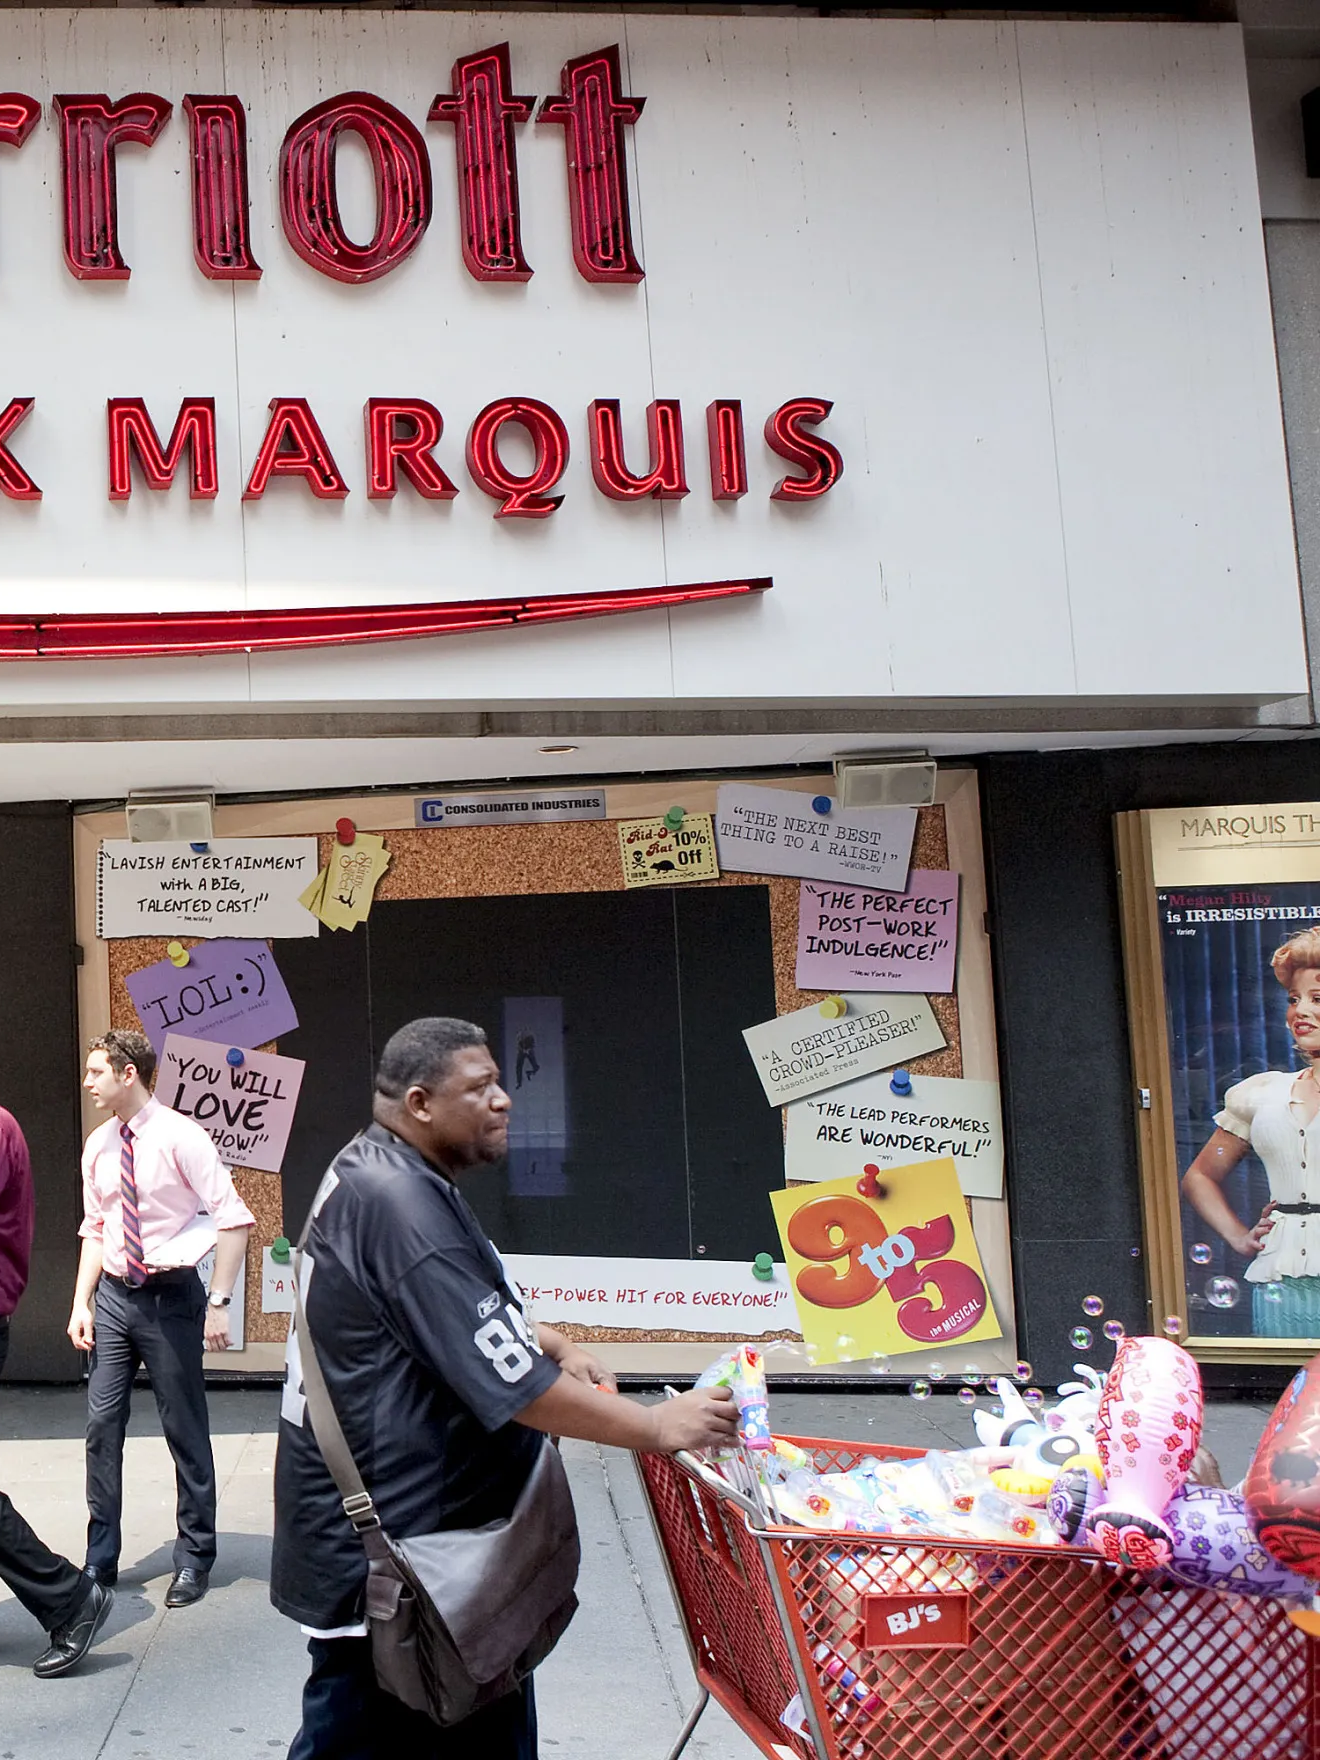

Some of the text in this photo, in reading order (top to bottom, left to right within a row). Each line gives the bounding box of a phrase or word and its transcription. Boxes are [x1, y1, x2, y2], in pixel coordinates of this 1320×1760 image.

[107, 397, 843, 518] MARQUIS
[445, 801, 529, 815] CONSOLIDATED
[531, 798, 600, 811] INDUSTRIES
[672, 830, 707, 847] 10%
[733, 806, 882, 846] "THE NEXT BEST
[1181, 814, 1287, 838] MARQUIS
[646, 841, 673, 857] Rat
[720, 822, 898, 865] THING TO A RAISE!"
[171, 855, 306, 870] ENTERTAINMENT
[678, 849, 702, 866] Off
[160, 877, 193, 892] with
[197, 878, 208, 891] A
[137, 898, 210, 914] TALENTED
[805, 885, 954, 916] "THE PERFECT
[818, 914, 937, 938] POST-WORK
[1166, 911, 1181, 923] is
[806, 935, 948, 961] INDULGENCE!"
[791, 1009, 890, 1055] CERTIFIED
[769, 1014, 922, 1082] CROWD-PLEASER!"
[167, 1053, 286, 1100] "YOU WILL
[833, 1058, 859, 1072] Press
[172, 1082, 269, 1131] LOVE
[850, 1106, 886, 1121] LEAD
[891, 1110, 990, 1134] PERFORMERS
[204, 1128, 269, 1153] HOW!"
[816, 1125, 991, 1158] ARE WONDERFUL!"
[616, 1289, 649, 1304] HIT
[654, 1291, 687, 1305] FOR
[693, 1291, 788, 1308] EVERYONE!"
[929, 1299, 981, 1337] the MUSICAL
[886, 1603, 942, 1636] BJ's
